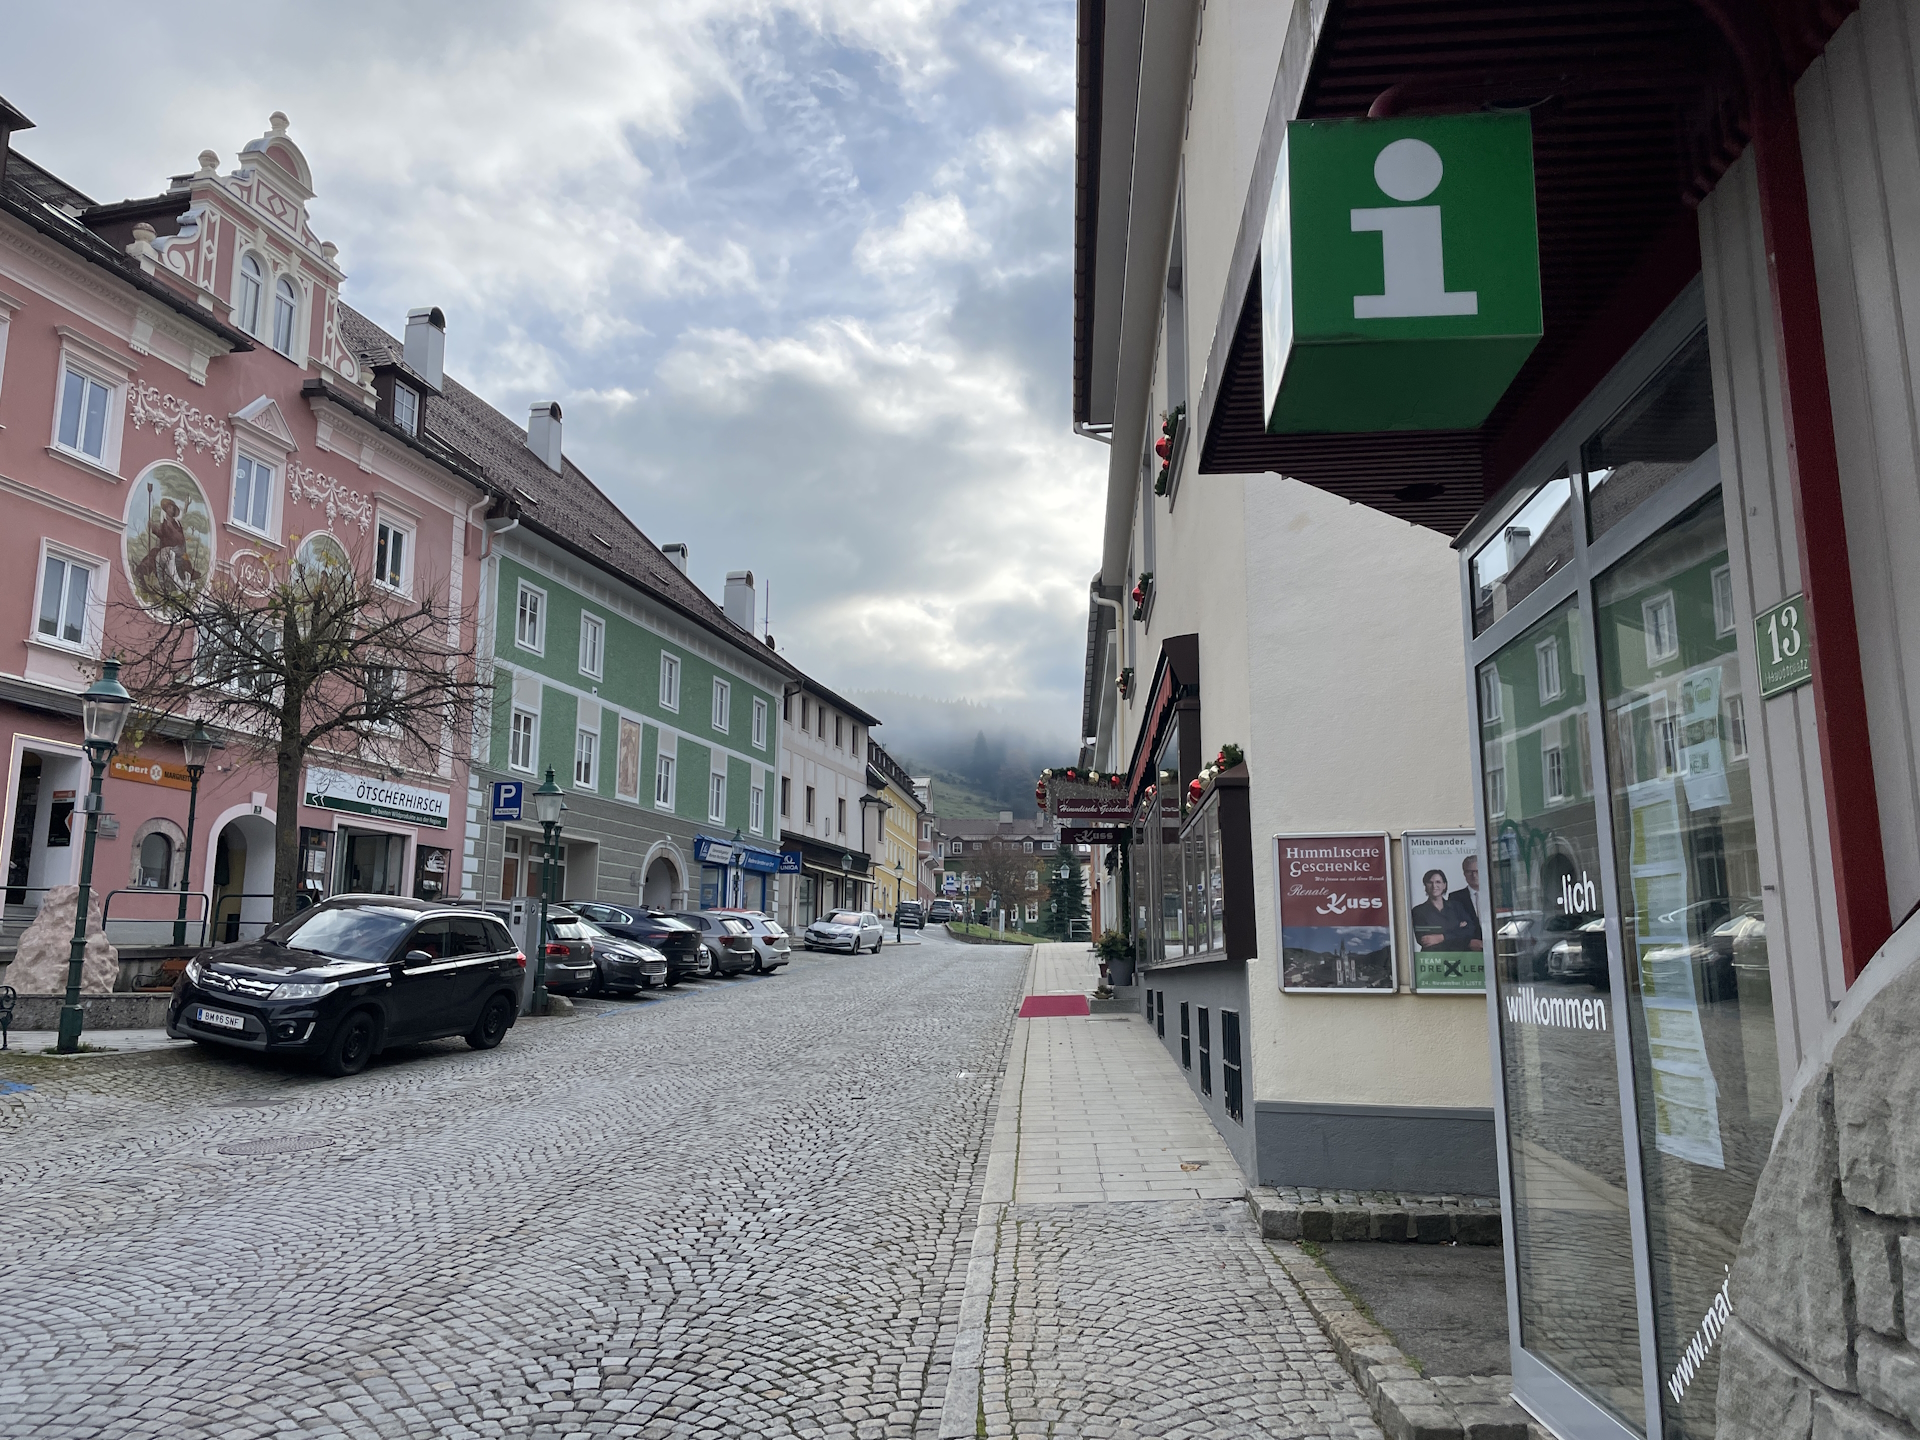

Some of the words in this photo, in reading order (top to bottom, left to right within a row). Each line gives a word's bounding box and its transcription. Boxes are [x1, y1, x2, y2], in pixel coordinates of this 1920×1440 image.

[1767, 605, 1801, 665] 13
[356, 781, 442, 814] ÖTSCHERHIRSCH
[500, 784, 516, 807] P
[1073, 829, 1113, 843] Kuss
[1411, 838, 1466, 846] Miteinander.
[1287, 884, 1329, 897] Renate
[1315, 893, 1383, 915] Kuss
[1557, 870, 1596, 915] -lich
[1506, 986, 1607, 1031] willkommen
[1668, 1263, 1733, 1404] www.mar
